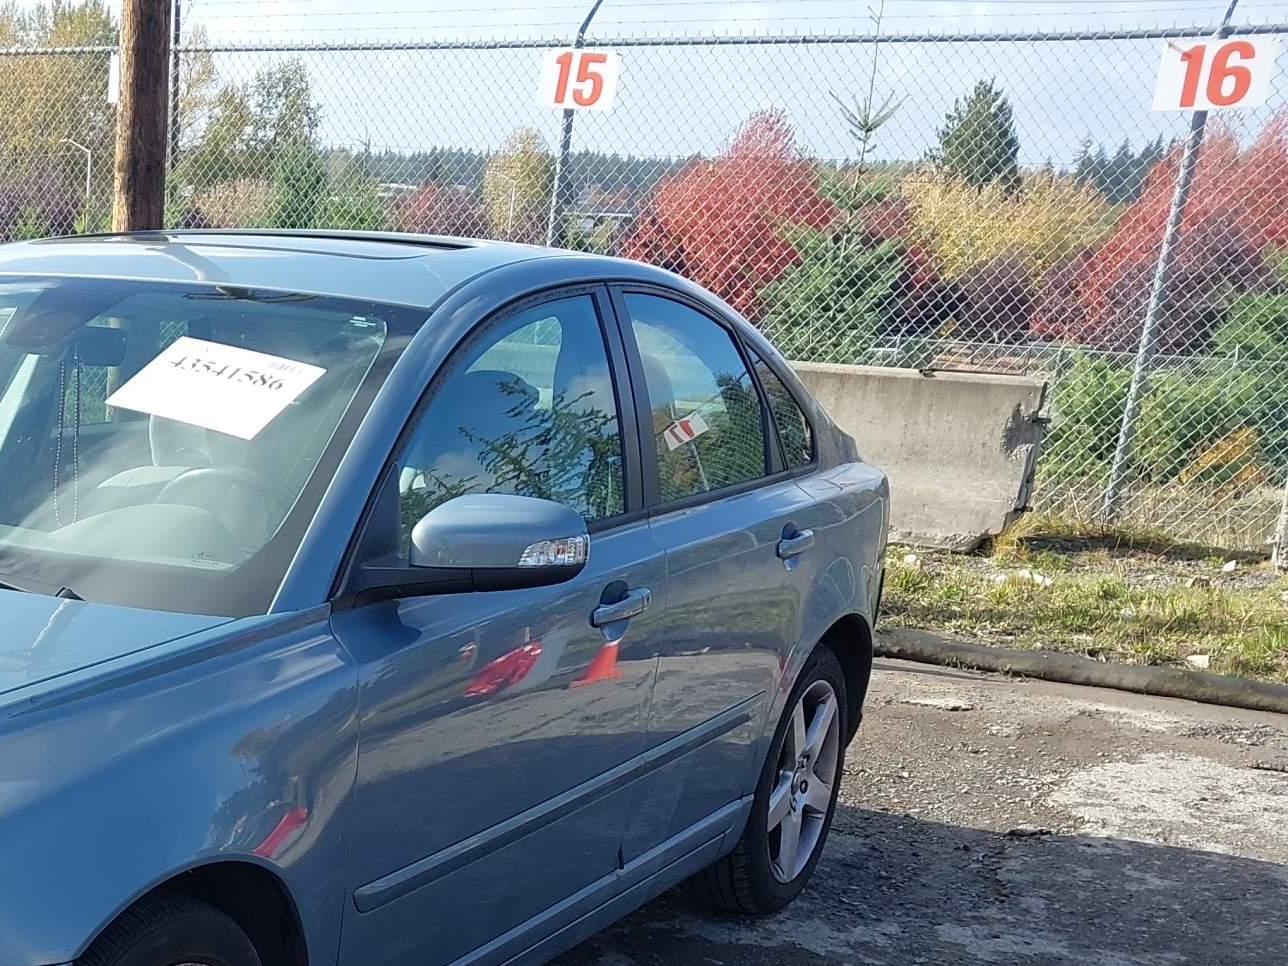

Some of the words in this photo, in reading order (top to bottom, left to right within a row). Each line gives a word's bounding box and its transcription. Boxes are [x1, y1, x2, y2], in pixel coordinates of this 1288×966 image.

[553, 51, 608, 107] 15
[1179, 41, 1256, 107] 16
[168, 356, 285, 391] 43541586
